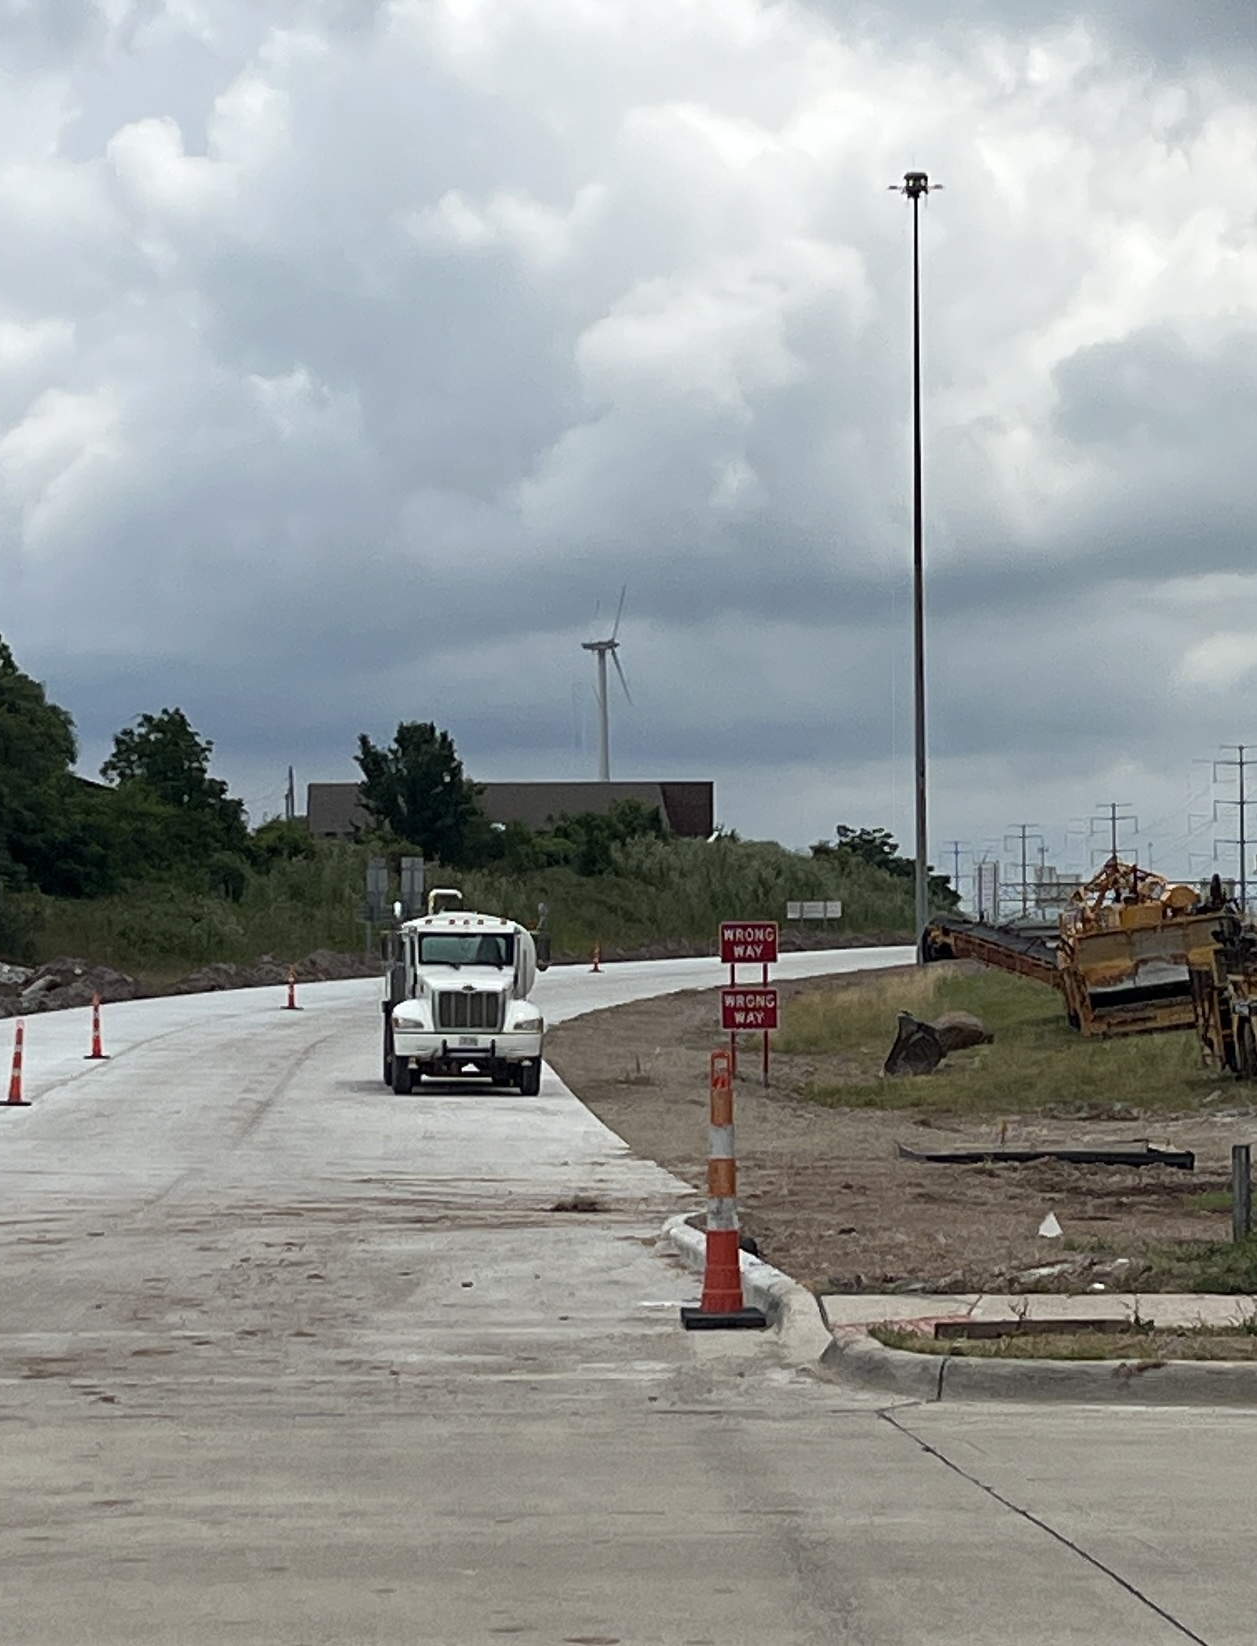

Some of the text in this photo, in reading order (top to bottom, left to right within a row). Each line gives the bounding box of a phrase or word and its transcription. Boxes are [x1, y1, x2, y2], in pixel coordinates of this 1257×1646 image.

[724, 928, 775, 941] WRONG
[733, 945, 763, 958] WAY
[724, 994, 775, 1008] WRONG
[734, 1011, 764, 1024] WAY
